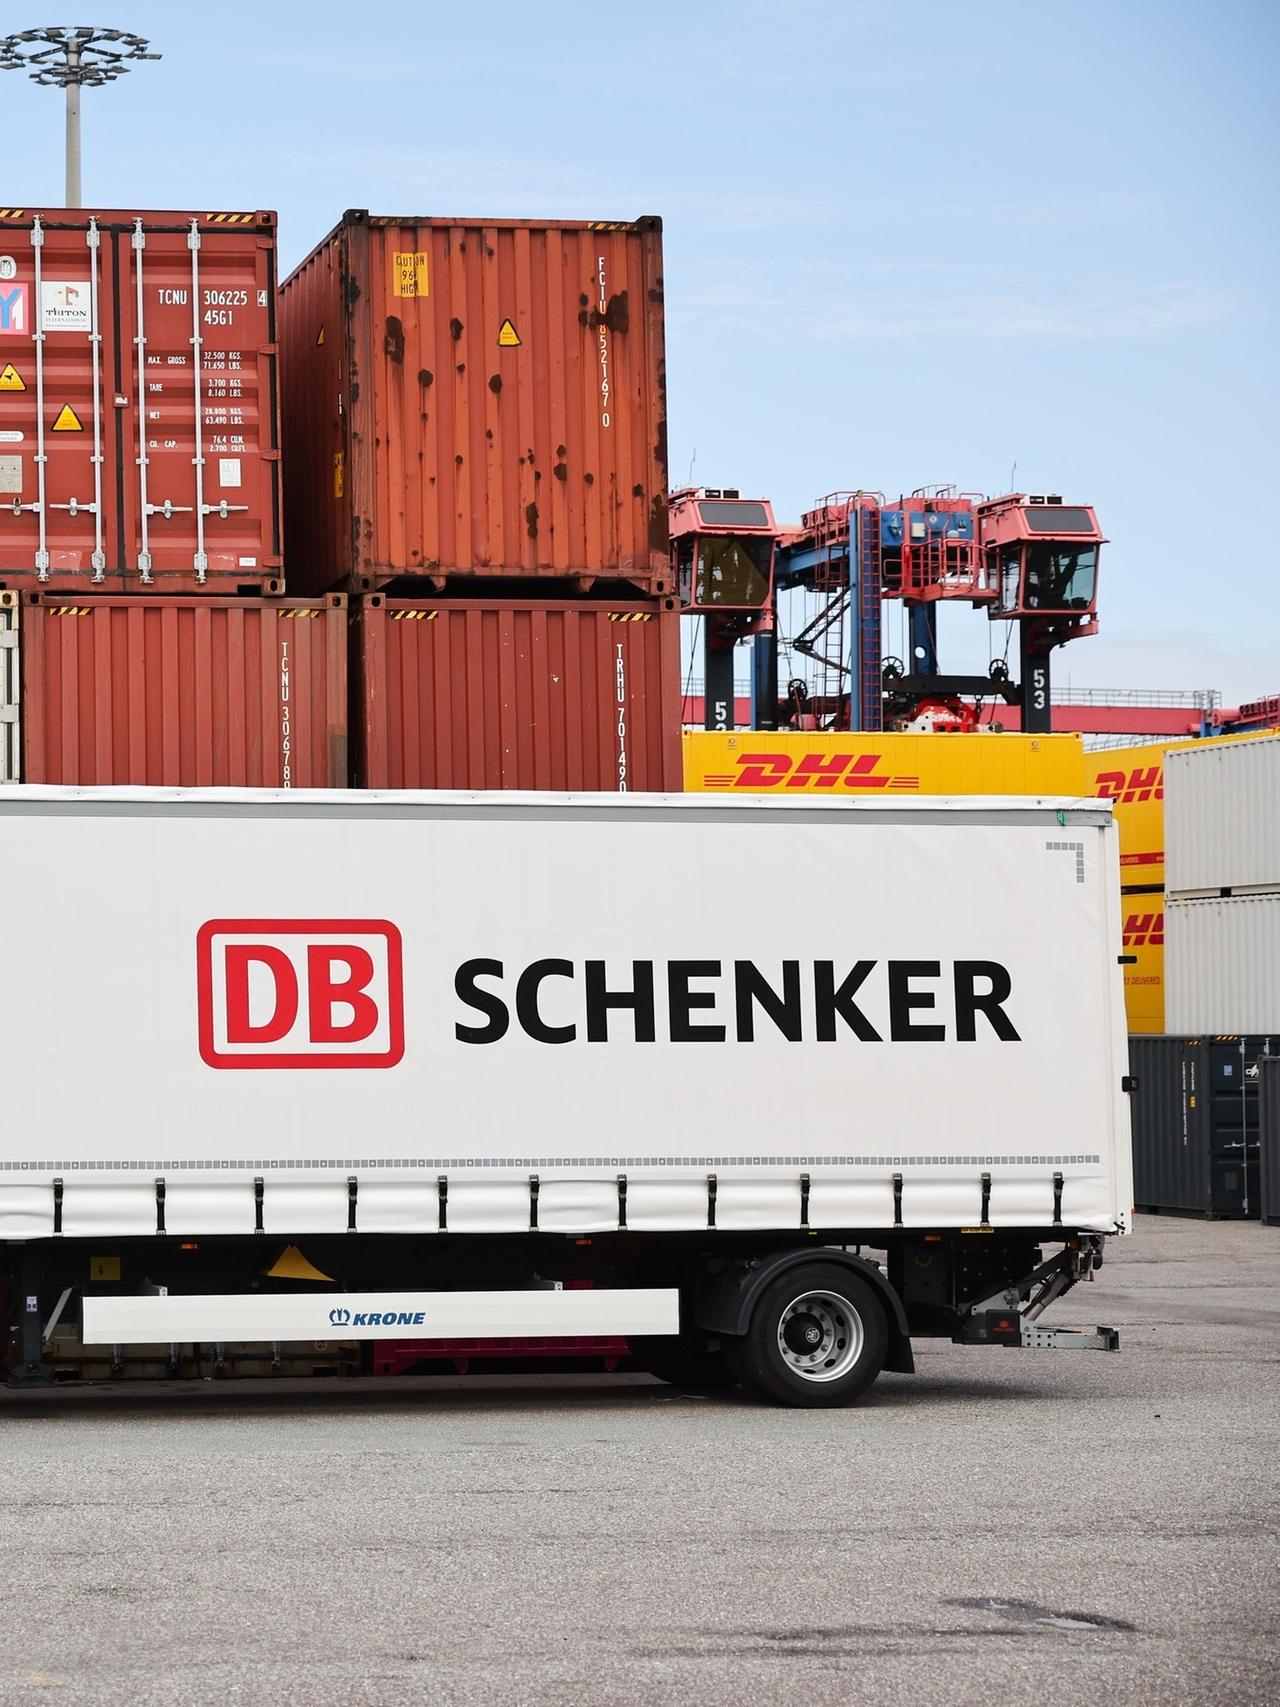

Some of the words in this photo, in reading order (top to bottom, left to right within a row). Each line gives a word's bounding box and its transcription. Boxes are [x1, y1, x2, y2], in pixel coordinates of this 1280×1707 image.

[599, 257, 607, 314] FCIU
[158, 290, 187, 304] TCNU
[204, 290, 248, 305] 306225
[258, 290, 268, 306] 4
[46, 308, 86, 316] TRITON
[204, 310, 232, 325] 45G1
[168, 356, 186, 364] GROSS
[204, 352, 225, 360] 32.500
[204, 362, 225, 370] 71.650
[150, 384, 163, 392] TARE
[208, 379, 226, 387] 3.700
[230, 380, 243, 388] KGS.
[208, 389, 226, 397] 8.160
[206, 416, 227, 424] 63.490
[213, 436, 227, 444] 76.4
[616, 644, 624, 702] TRHU
[617, 708, 626, 792] 701490
[734, 754, 890, 787] DHL
[224, 944, 380, 1044] DB
[454, 958, 1022, 1045] SCHENKER
[352, 1312, 426, 1326] KRONE
